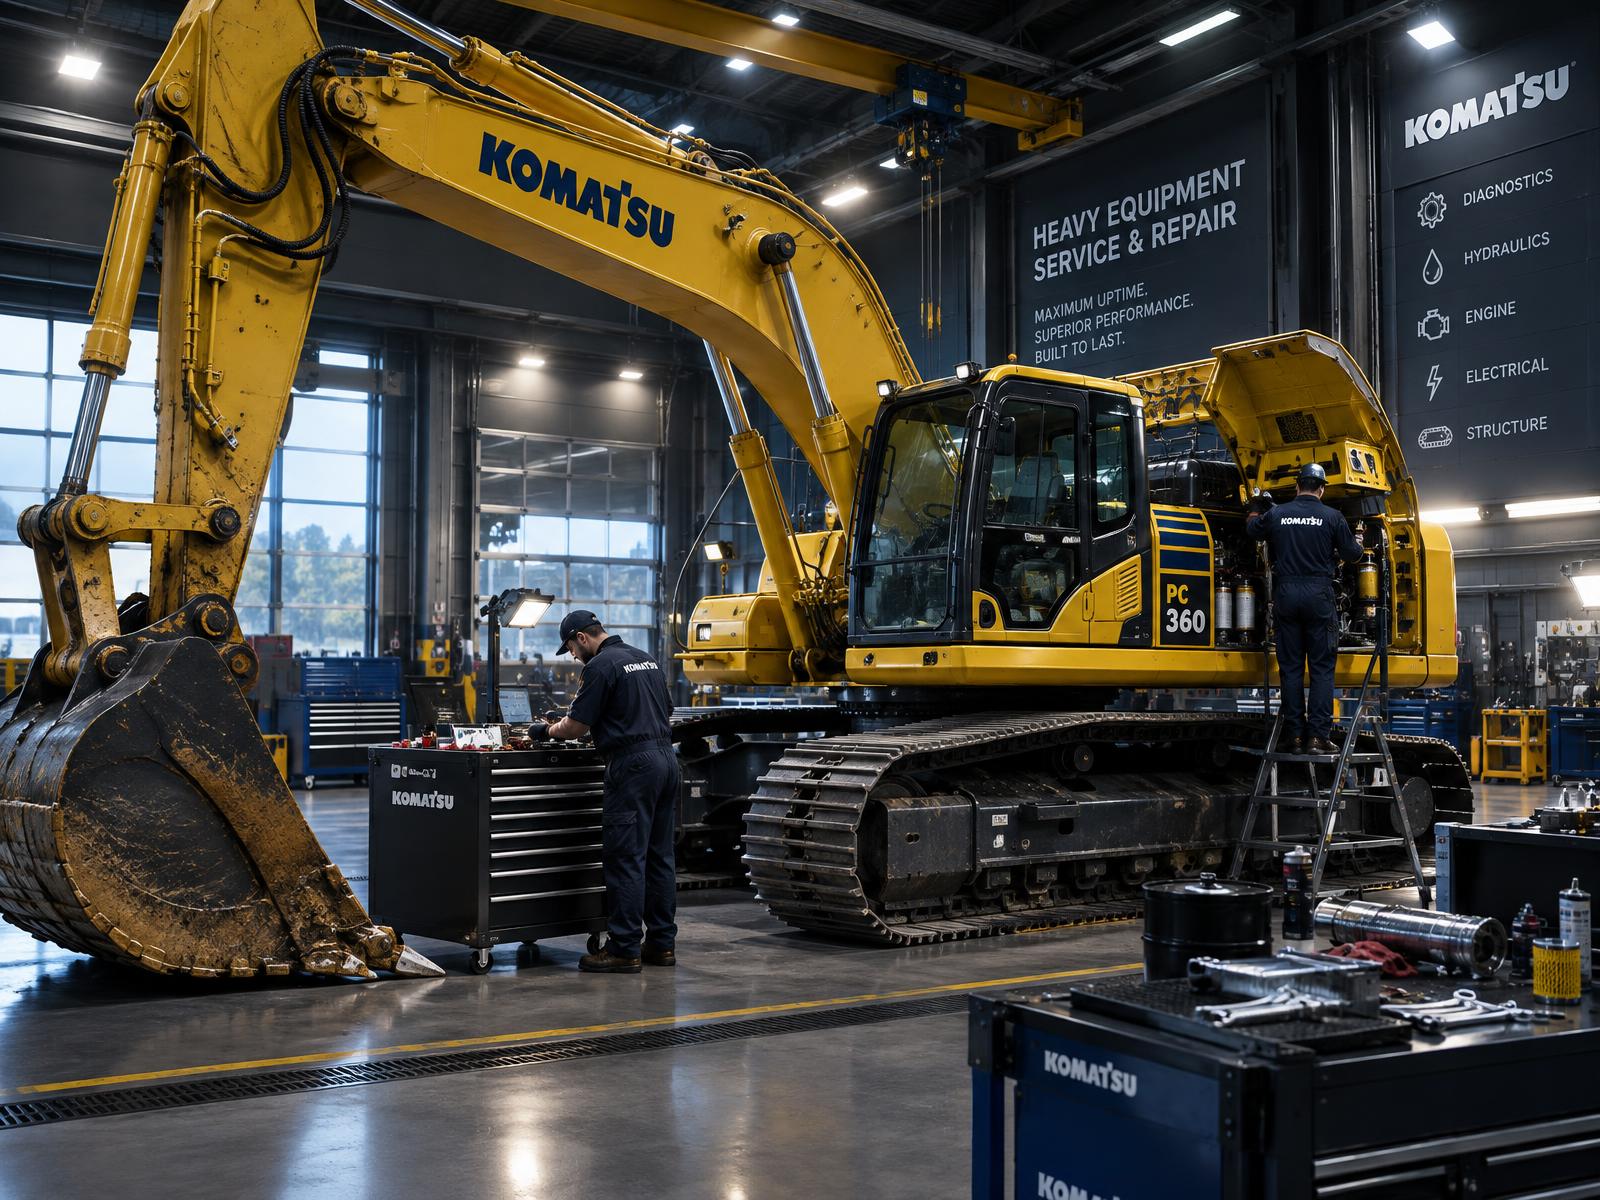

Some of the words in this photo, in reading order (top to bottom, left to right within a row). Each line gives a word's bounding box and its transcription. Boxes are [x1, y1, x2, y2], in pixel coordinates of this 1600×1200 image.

[1405, 65, 1568, 148] KOMATSU
[479, 132, 674, 247] KOMATSU
[1464, 169, 1552, 206] DIAGNOSTICS
[1034, 207, 1100, 249] HEAVY
[1108, 159, 1245, 226] EQUIPMENT
[1034, 235, 1120, 281] SERVICE
[1128, 229, 1143, 254] &
[1152, 201, 1236, 248] REPAIR
[1465, 232, 1549, 264] HYDRAULICS
[1035, 296, 1092, 323] MAXIMUM
[1098, 283, 1147, 306] UPTIME.
[1035, 318, 1091, 343] SUPERIOR
[1096, 294, 1193, 328] PERFORMANCE.
[1466, 301, 1516, 324] ENGINE
[1035, 345, 1067, 364] BUILT
[1072, 340, 1087, 355] TO
[1092, 332, 1125, 350] LAST.
[1467, 358, 1549, 383] ELECTRICAL
[1467, 416, 1547, 439] STRUCTURE
[1281, 516, 1322, 526] KOMATSU
[1167, 584, 1188, 604] PC
[1166, 608, 1205, 633] 360
[392, 791, 453, 809] KOMATSU
[1045, 1051, 1137, 1097] KOMATSU
